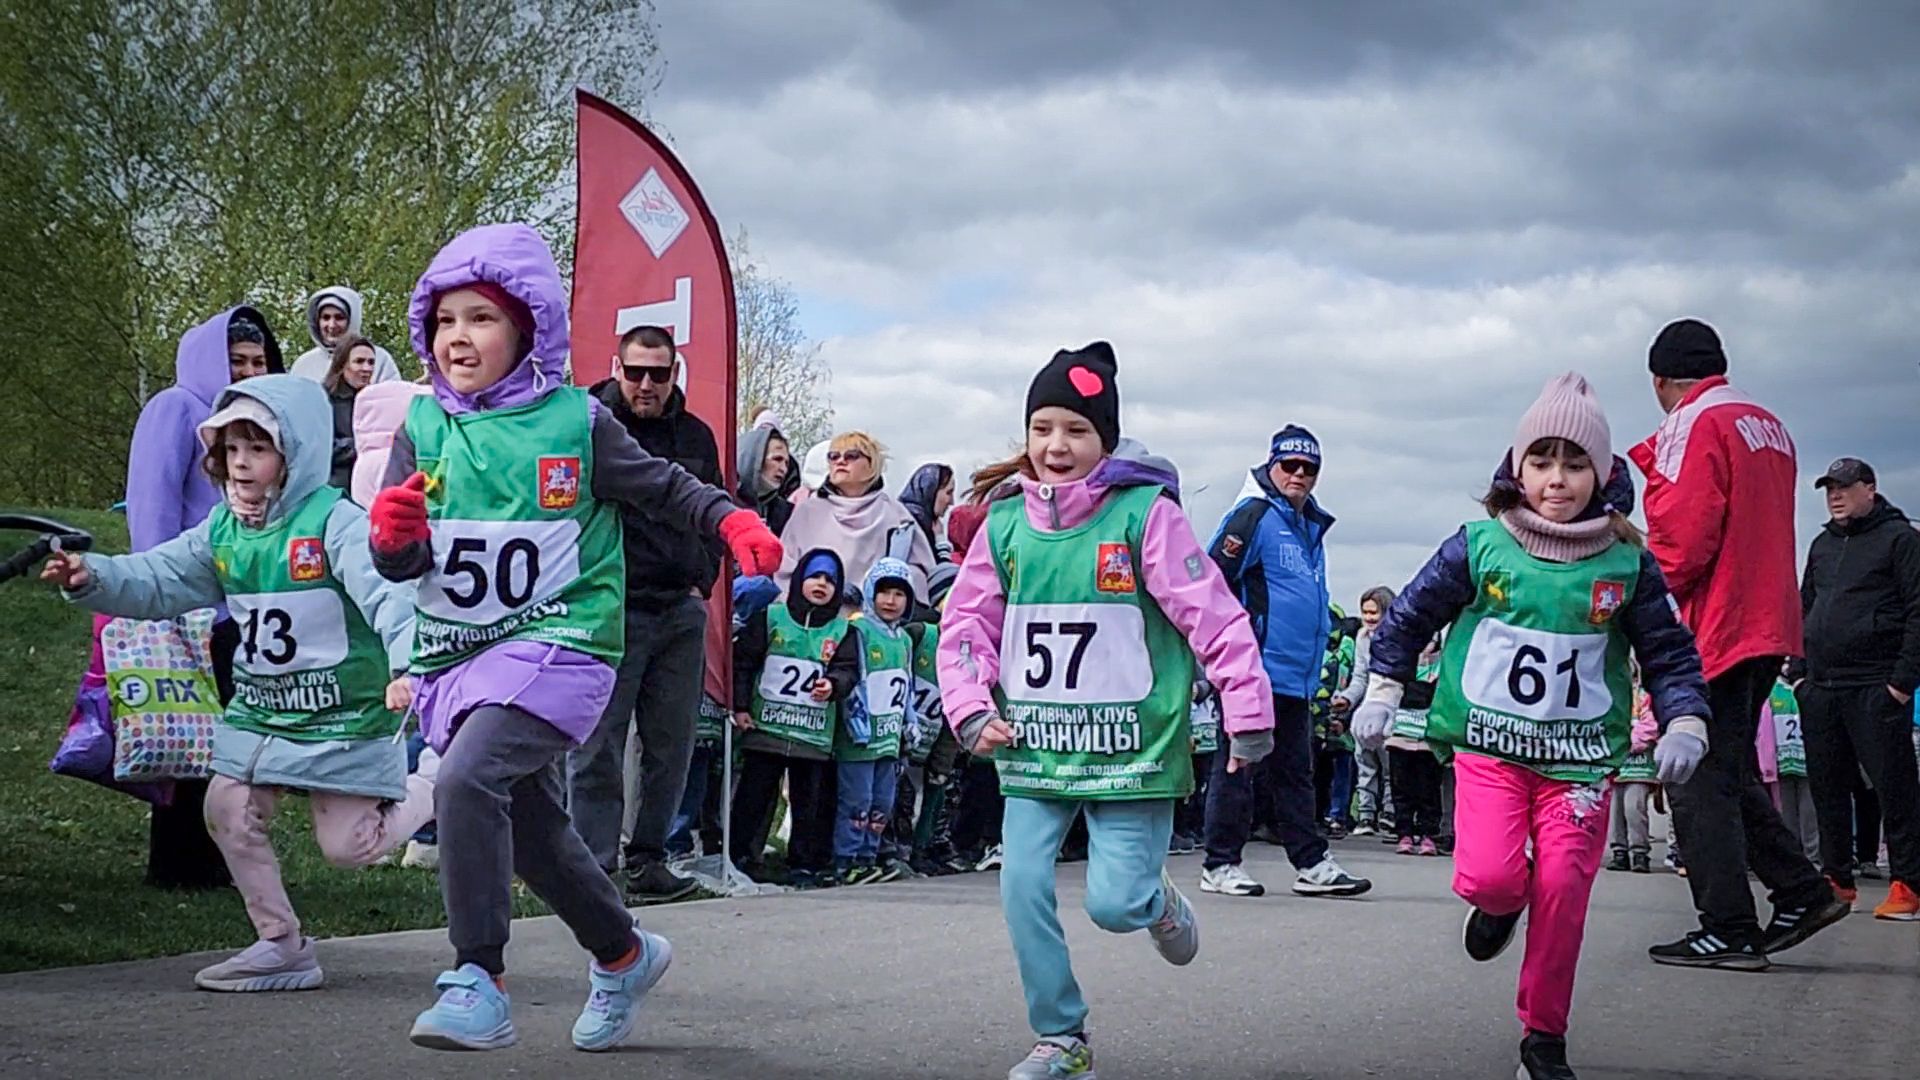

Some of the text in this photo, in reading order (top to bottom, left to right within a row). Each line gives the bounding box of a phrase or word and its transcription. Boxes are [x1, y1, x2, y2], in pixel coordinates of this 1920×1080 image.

[441, 538, 540, 609] 50
[1025, 622, 1098, 690] 57
[155, 677, 202, 703] FIX
[297, 670, 337, 687] КЛУБ
[1508, 644, 1581, 709] 61
[234, 683, 343, 712] РОННИЦЫ
[761, 709, 827, 731] БРОННИЦЫ
[1005, 703, 1138, 724] СПОРТИВНЫЙ КЛУБ
[1469, 708, 1567, 738] СПОРТИВНЫЙ
[1008, 721, 1141, 755] РОННИЦЫ
[1467, 723, 1612, 762] БРОННИЦЫ
